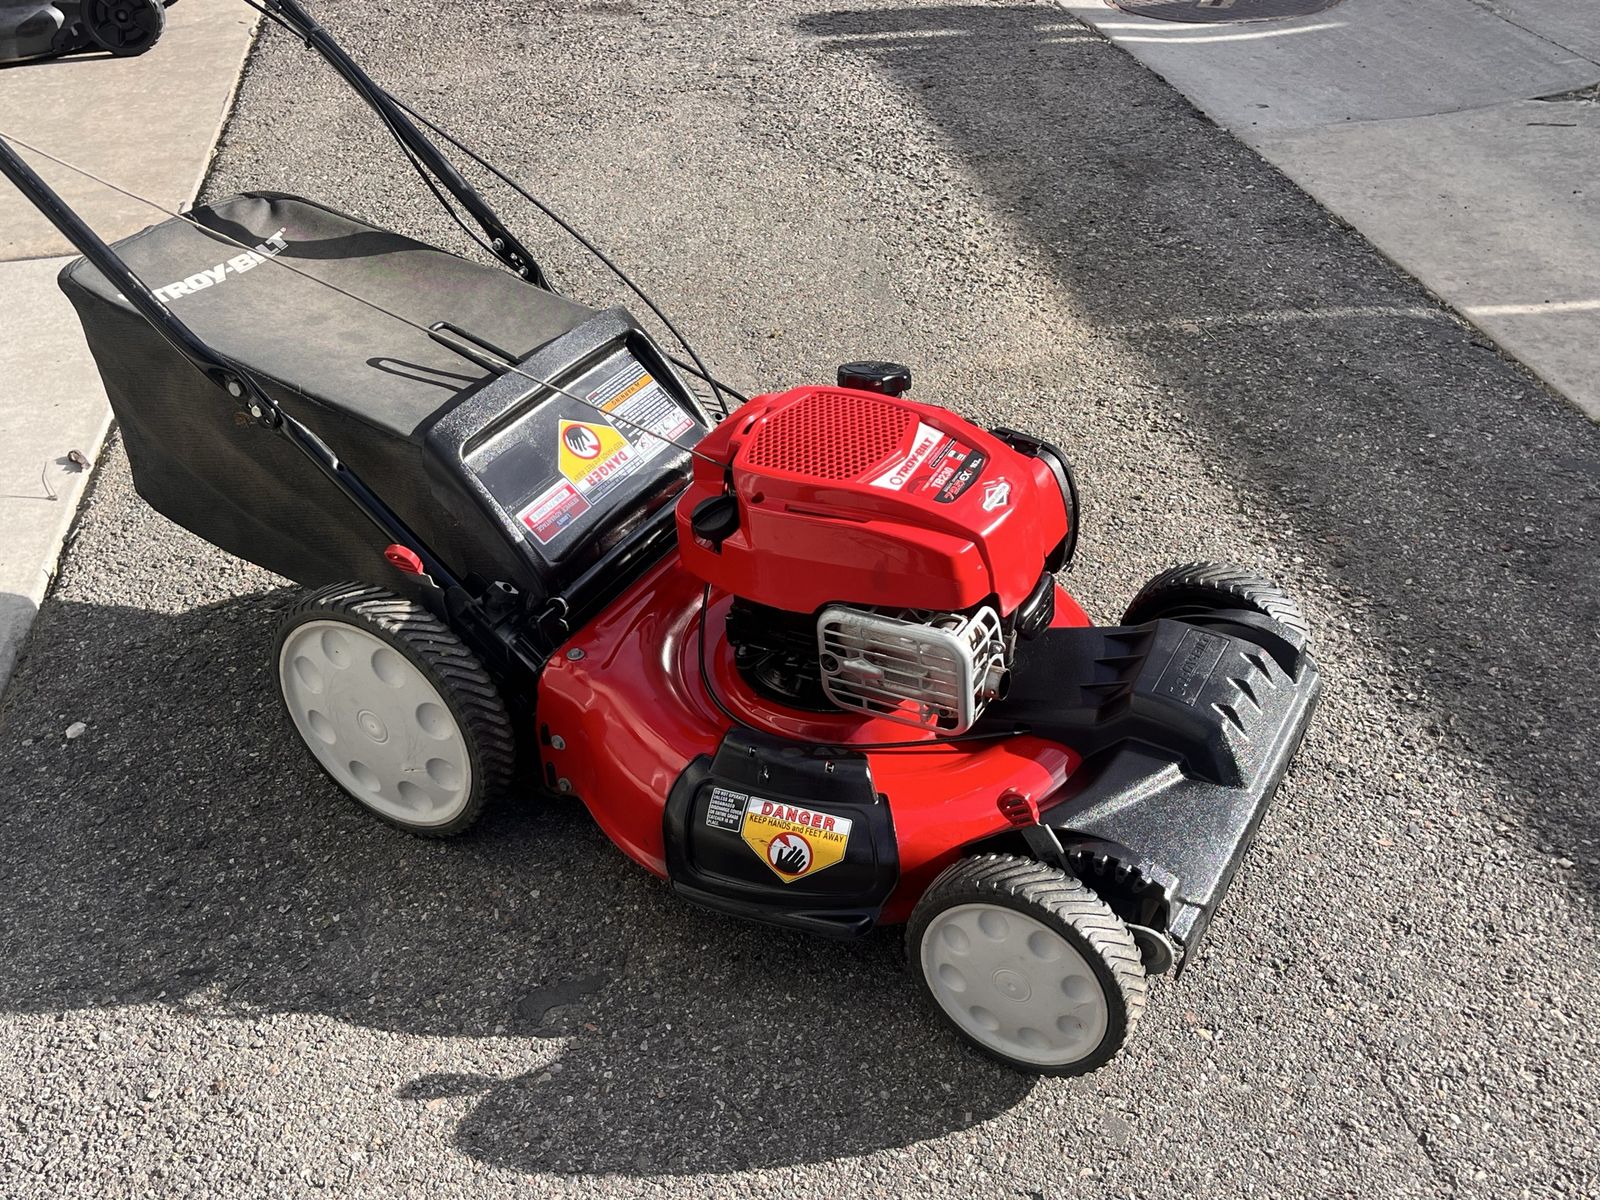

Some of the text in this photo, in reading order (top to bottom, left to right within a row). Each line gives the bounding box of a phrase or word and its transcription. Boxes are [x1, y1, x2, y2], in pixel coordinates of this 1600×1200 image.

[152, 230, 288, 303] TROY-BILT
[611, 387, 635, 406] WARNING
[585, 450, 629, 487] DANGER
[895, 437, 934, 478] TROY-BILT
[931, 466, 955, 489] TB230
[536, 510, 562, 532] ADVANTAGE
[750, 814, 767, 827] KEEP
[768, 819, 790, 830] HANDS
[805, 828, 822, 838] FEET
[823, 833, 844, 843] AWAY
[761, 801, 835, 831] DANGER
